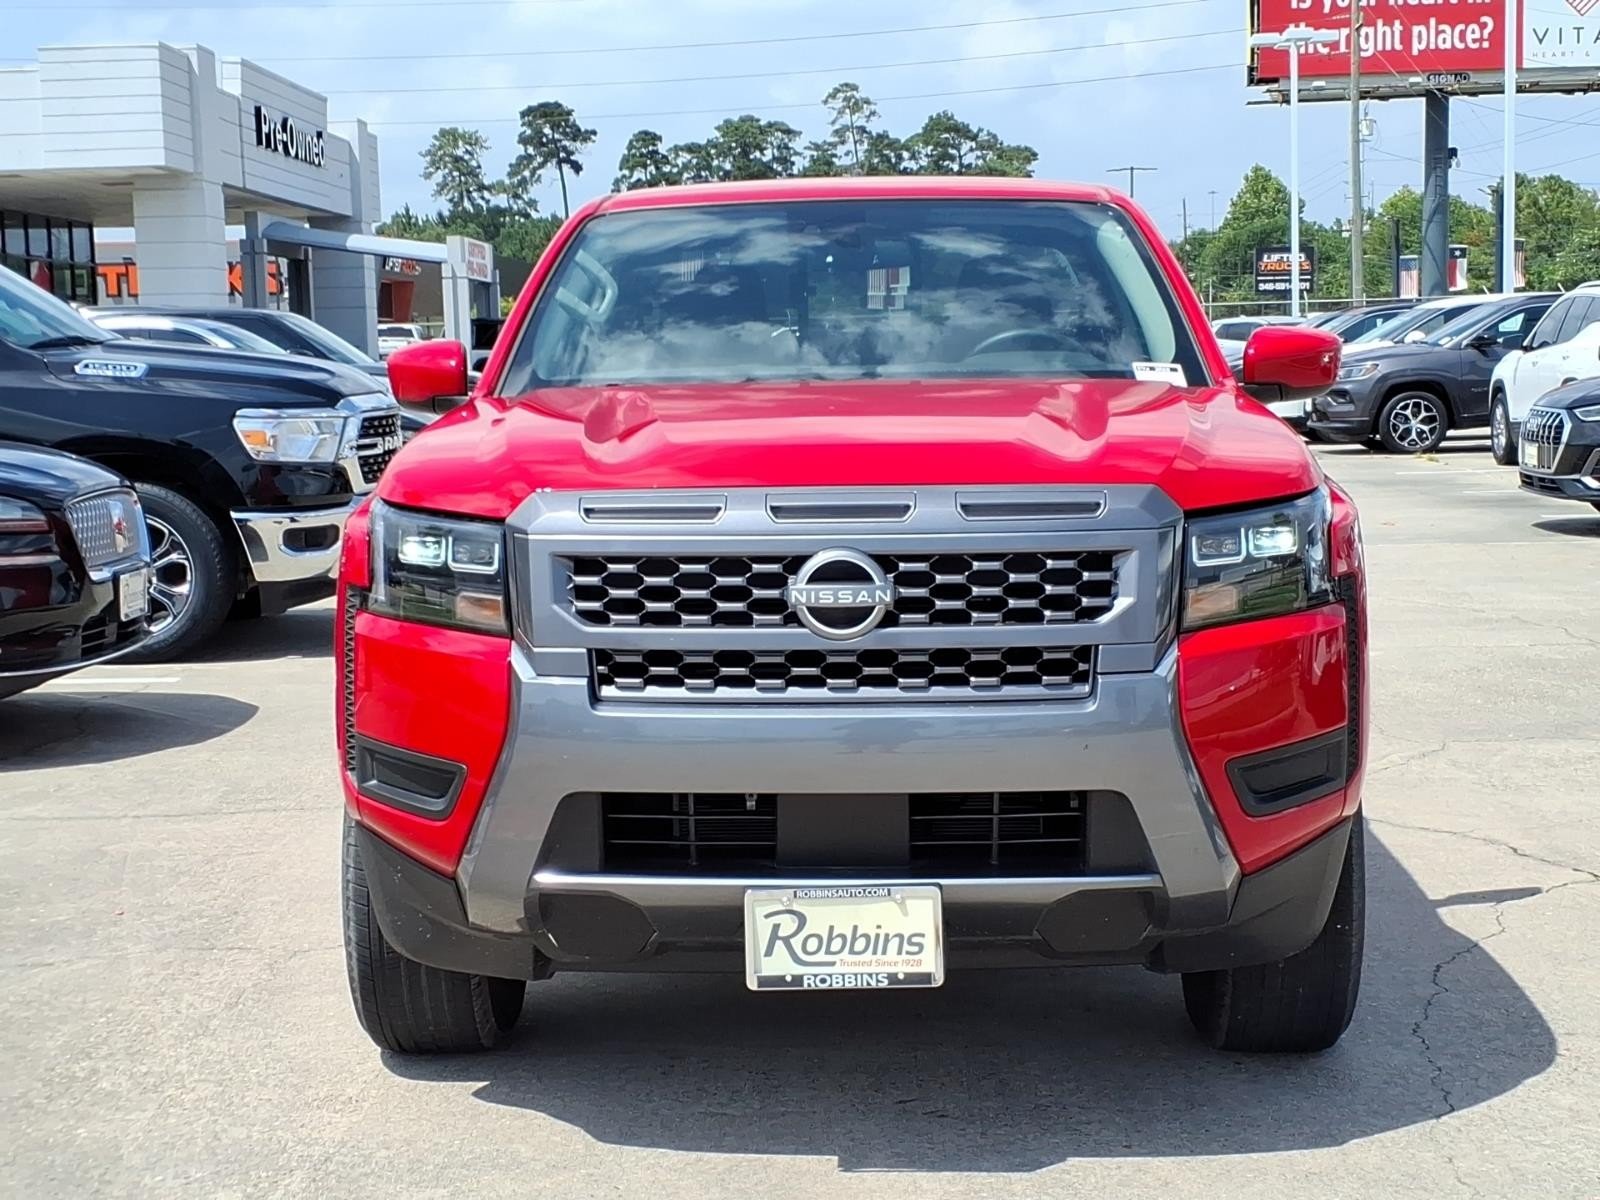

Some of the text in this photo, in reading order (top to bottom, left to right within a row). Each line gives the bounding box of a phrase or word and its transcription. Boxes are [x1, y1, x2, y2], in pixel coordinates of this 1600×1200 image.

[1289, 15, 1495, 57] he rght place?
[254, 105, 326, 168] Pre-Owned
[1262, 254, 1305, 262] LIFTD
[1259, 261, 1310, 271] TRUCS
[790, 588, 892, 605] NISSAN
[796, 887, 888, 899] ROBBINSAUTO.COM
[763, 908, 926, 967] Robbins
[839, 958, 923, 968] Trusted Since 1928
[803, 973, 889, 987] ROBBINS
